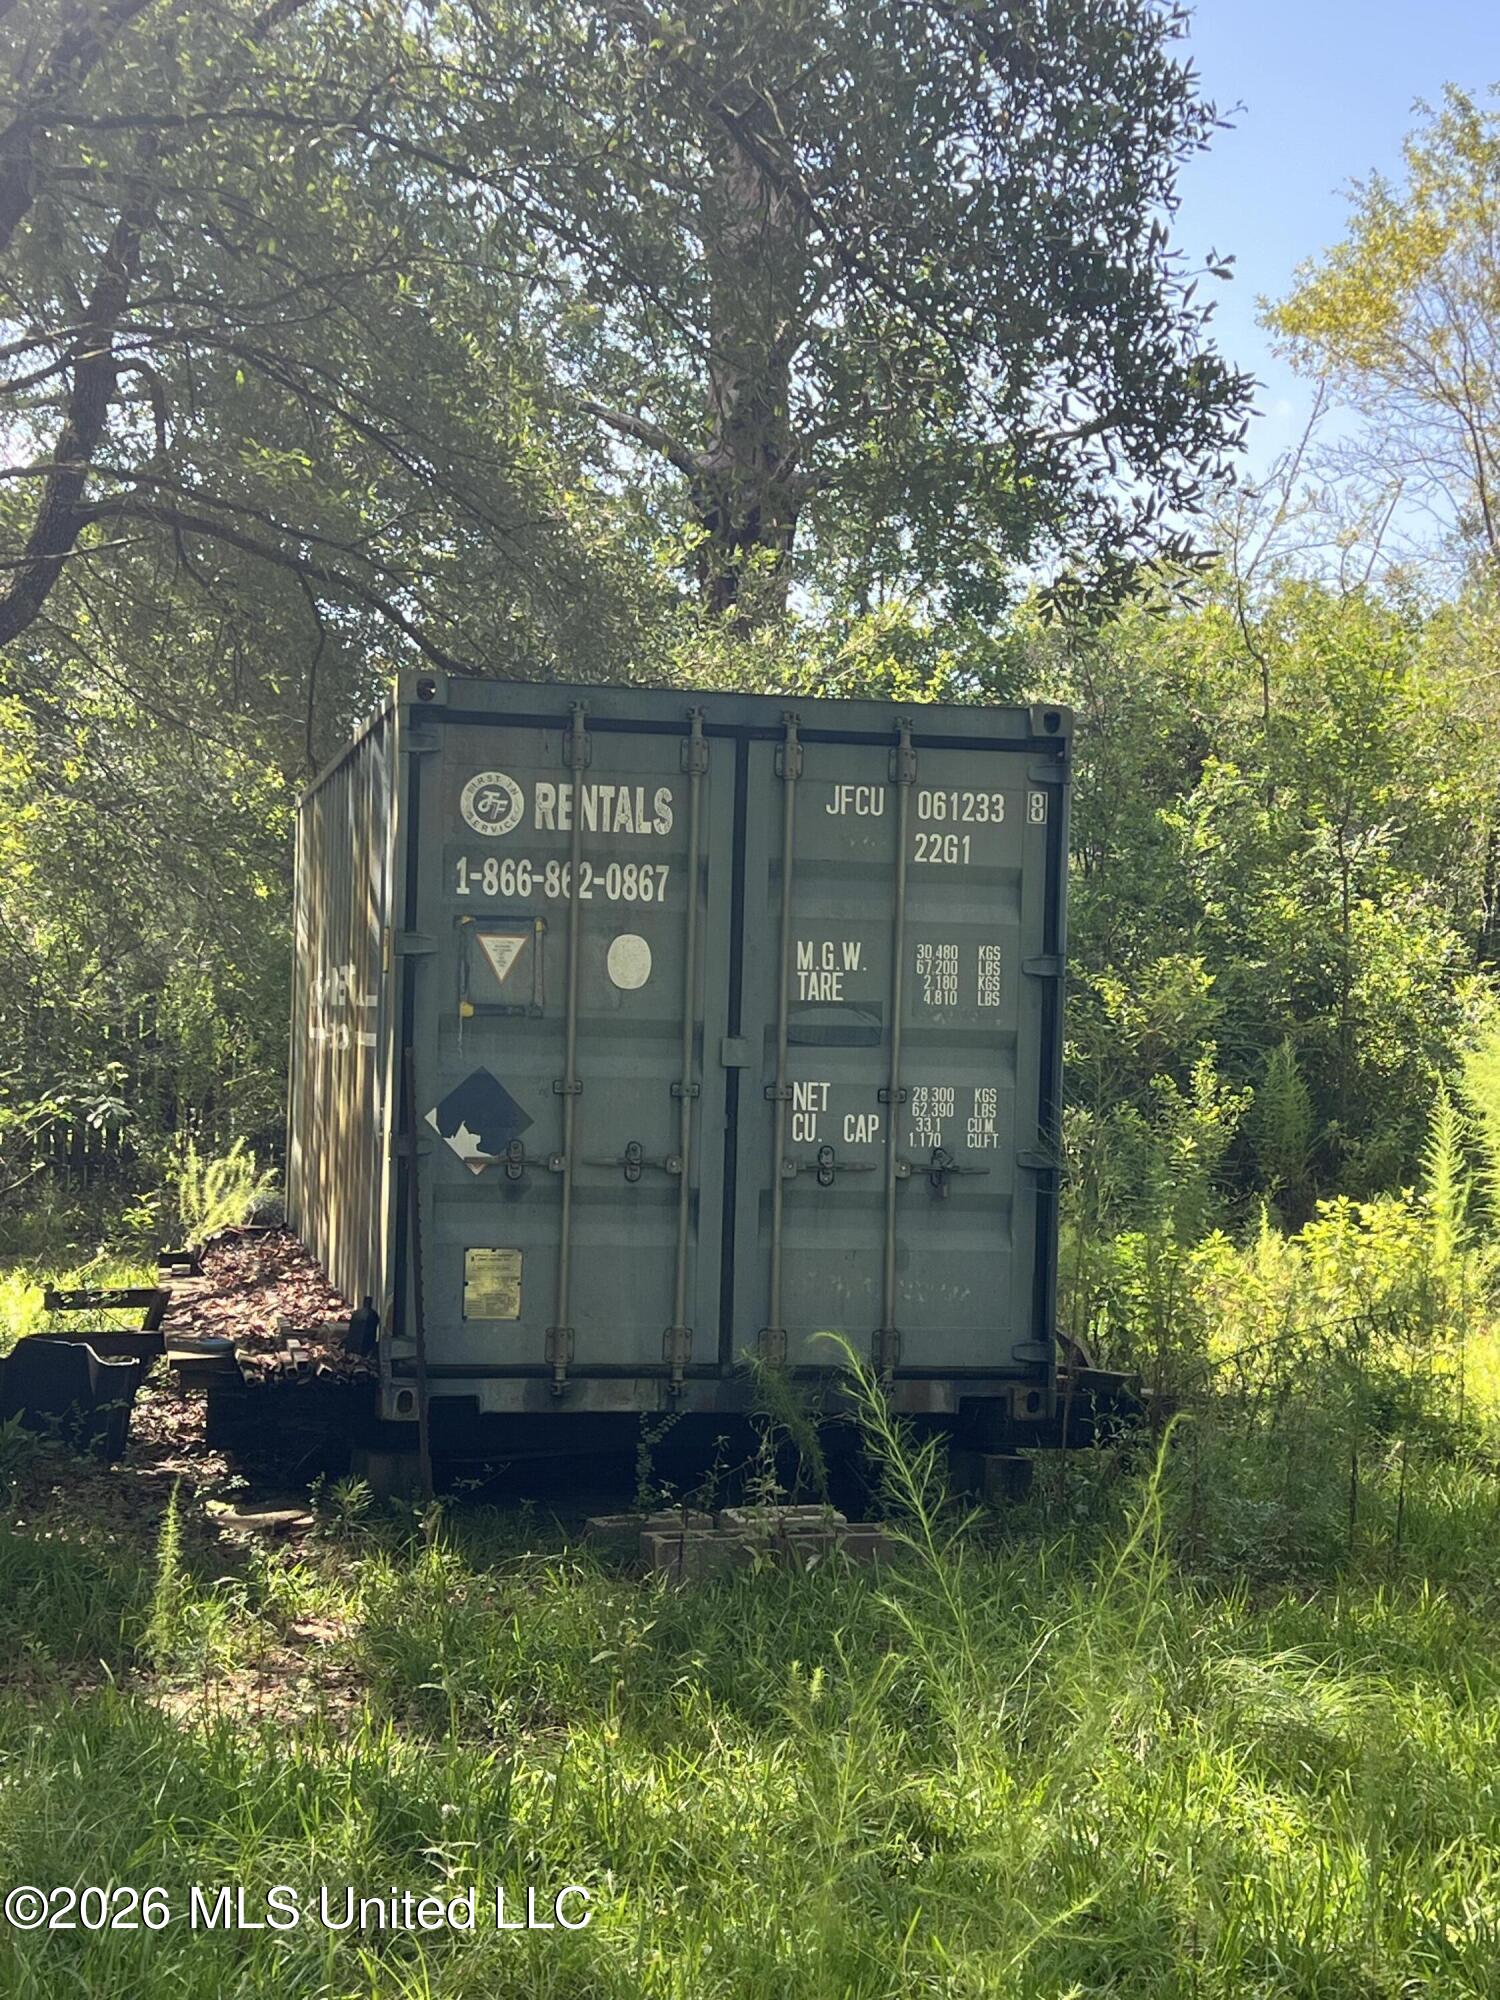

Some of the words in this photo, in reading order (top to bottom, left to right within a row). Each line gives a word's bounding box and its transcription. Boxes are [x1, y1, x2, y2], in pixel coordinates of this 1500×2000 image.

[534, 782, 673, 835] RENTALS
[825, 785, 885, 816] JFCU
[918, 791, 1005, 823] 061233
[1030, 793, 1044, 822] 8
[914, 833, 971, 864] 22G1
[797, 941, 867, 972] M.G.W.
[978, 945, 1001, 961] KGS
[978, 960, 1001, 976] LBS
[797, 972, 844, 1001] TARE
[977, 976, 1000, 991] KGS
[977, 991, 1000, 1007] LBS
[793, 1082, 830, 1111] NET
[974, 1087, 997, 1103] KGS
[974, 1103, 996, 1118] LBS
[792, 1113, 822, 1143] CU.
[844, 1114, 886, 1144] CAP.
